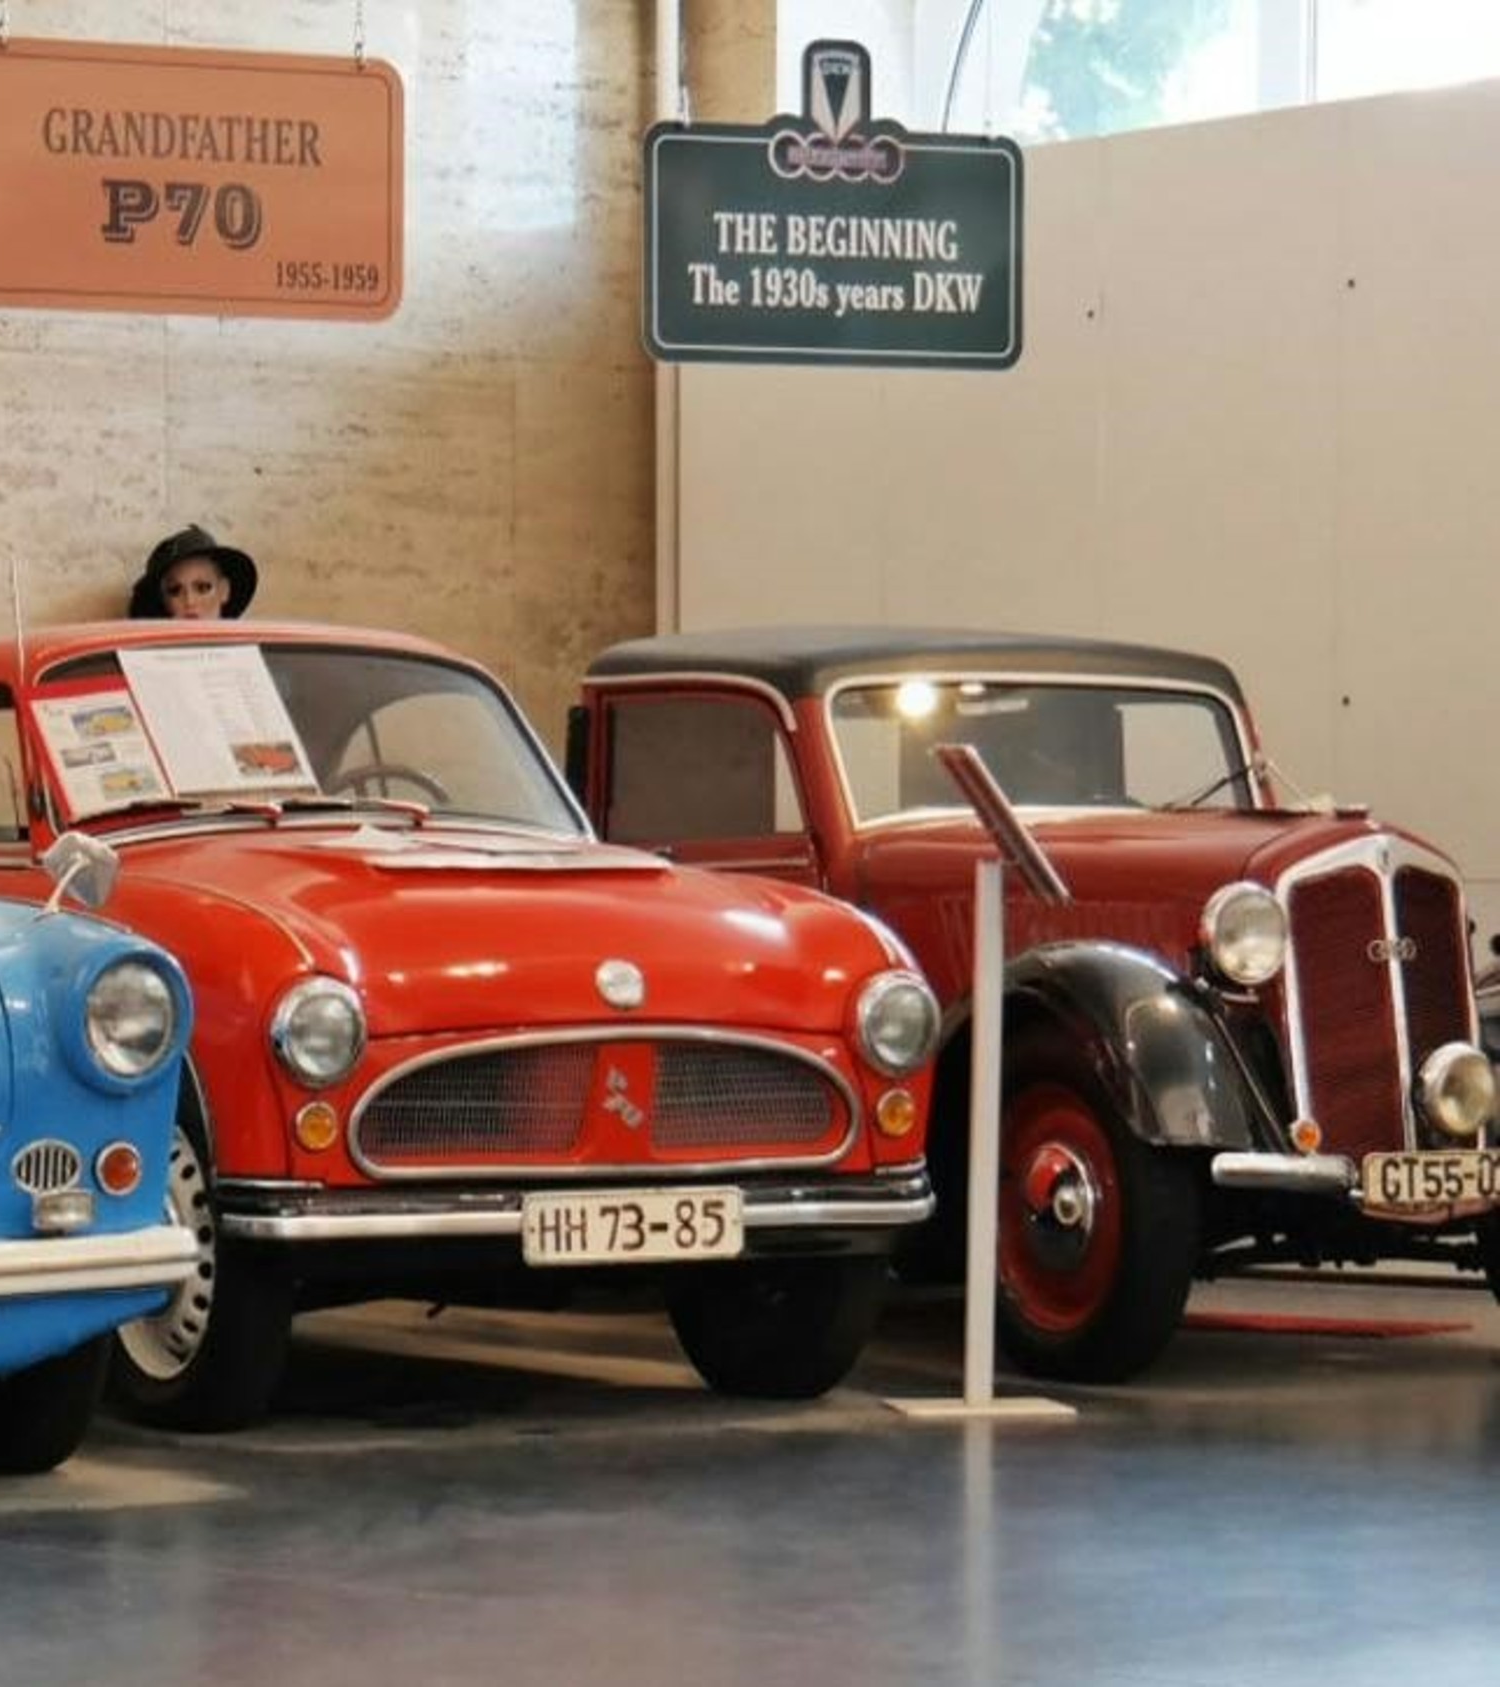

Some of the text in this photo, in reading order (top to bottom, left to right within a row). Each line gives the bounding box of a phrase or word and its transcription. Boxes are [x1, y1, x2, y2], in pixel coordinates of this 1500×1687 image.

[42, 106, 322, 167] GRANDFATHER
[100, 178, 263, 250] P70
[713, 211, 959, 261] THE BEGINNING
[275, 260, 380, 292] 1955-1959
[687, 263, 984, 318] The 1930s years DKW
[599, 1199, 726, 1252] 73-85
